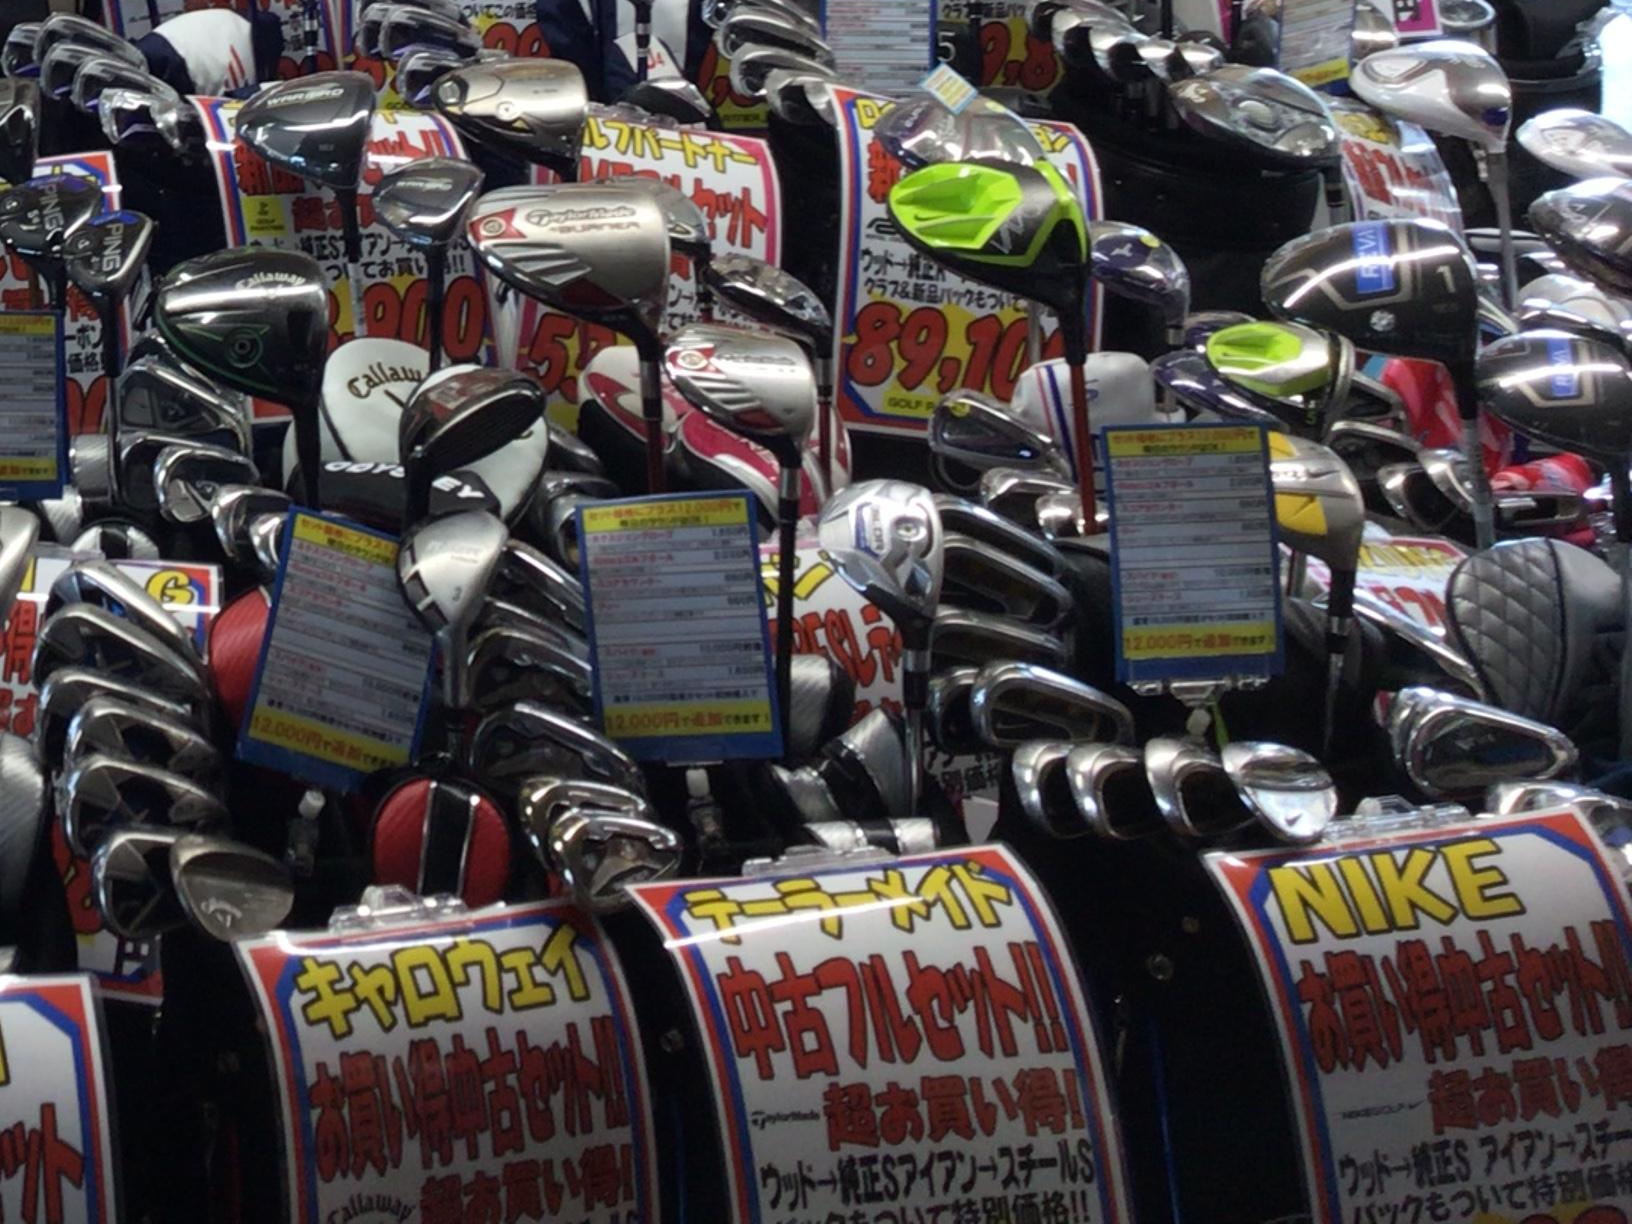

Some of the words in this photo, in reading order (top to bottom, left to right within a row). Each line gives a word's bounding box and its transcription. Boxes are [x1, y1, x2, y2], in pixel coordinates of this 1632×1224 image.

[936, 31, 957, 63] 5
[582, 115, 758, 174] ルフパートナー
[42, 183, 65, 231] PING
[102, 223, 124, 271] PING
[347, 361, 423, 400] Callaw
[684, 860, 1014, 946] テーラーメイド
[1267, 837, 1527, 946] NIKE
[295, 921, 593, 1042] キャロウェイ
[716, 939, 1071, 1081] 中古フルセット!!
[310, 1014, 631, 1184] お買い得中古セット!!
[823, 1067, 1086, 1152] 超お買い得!
